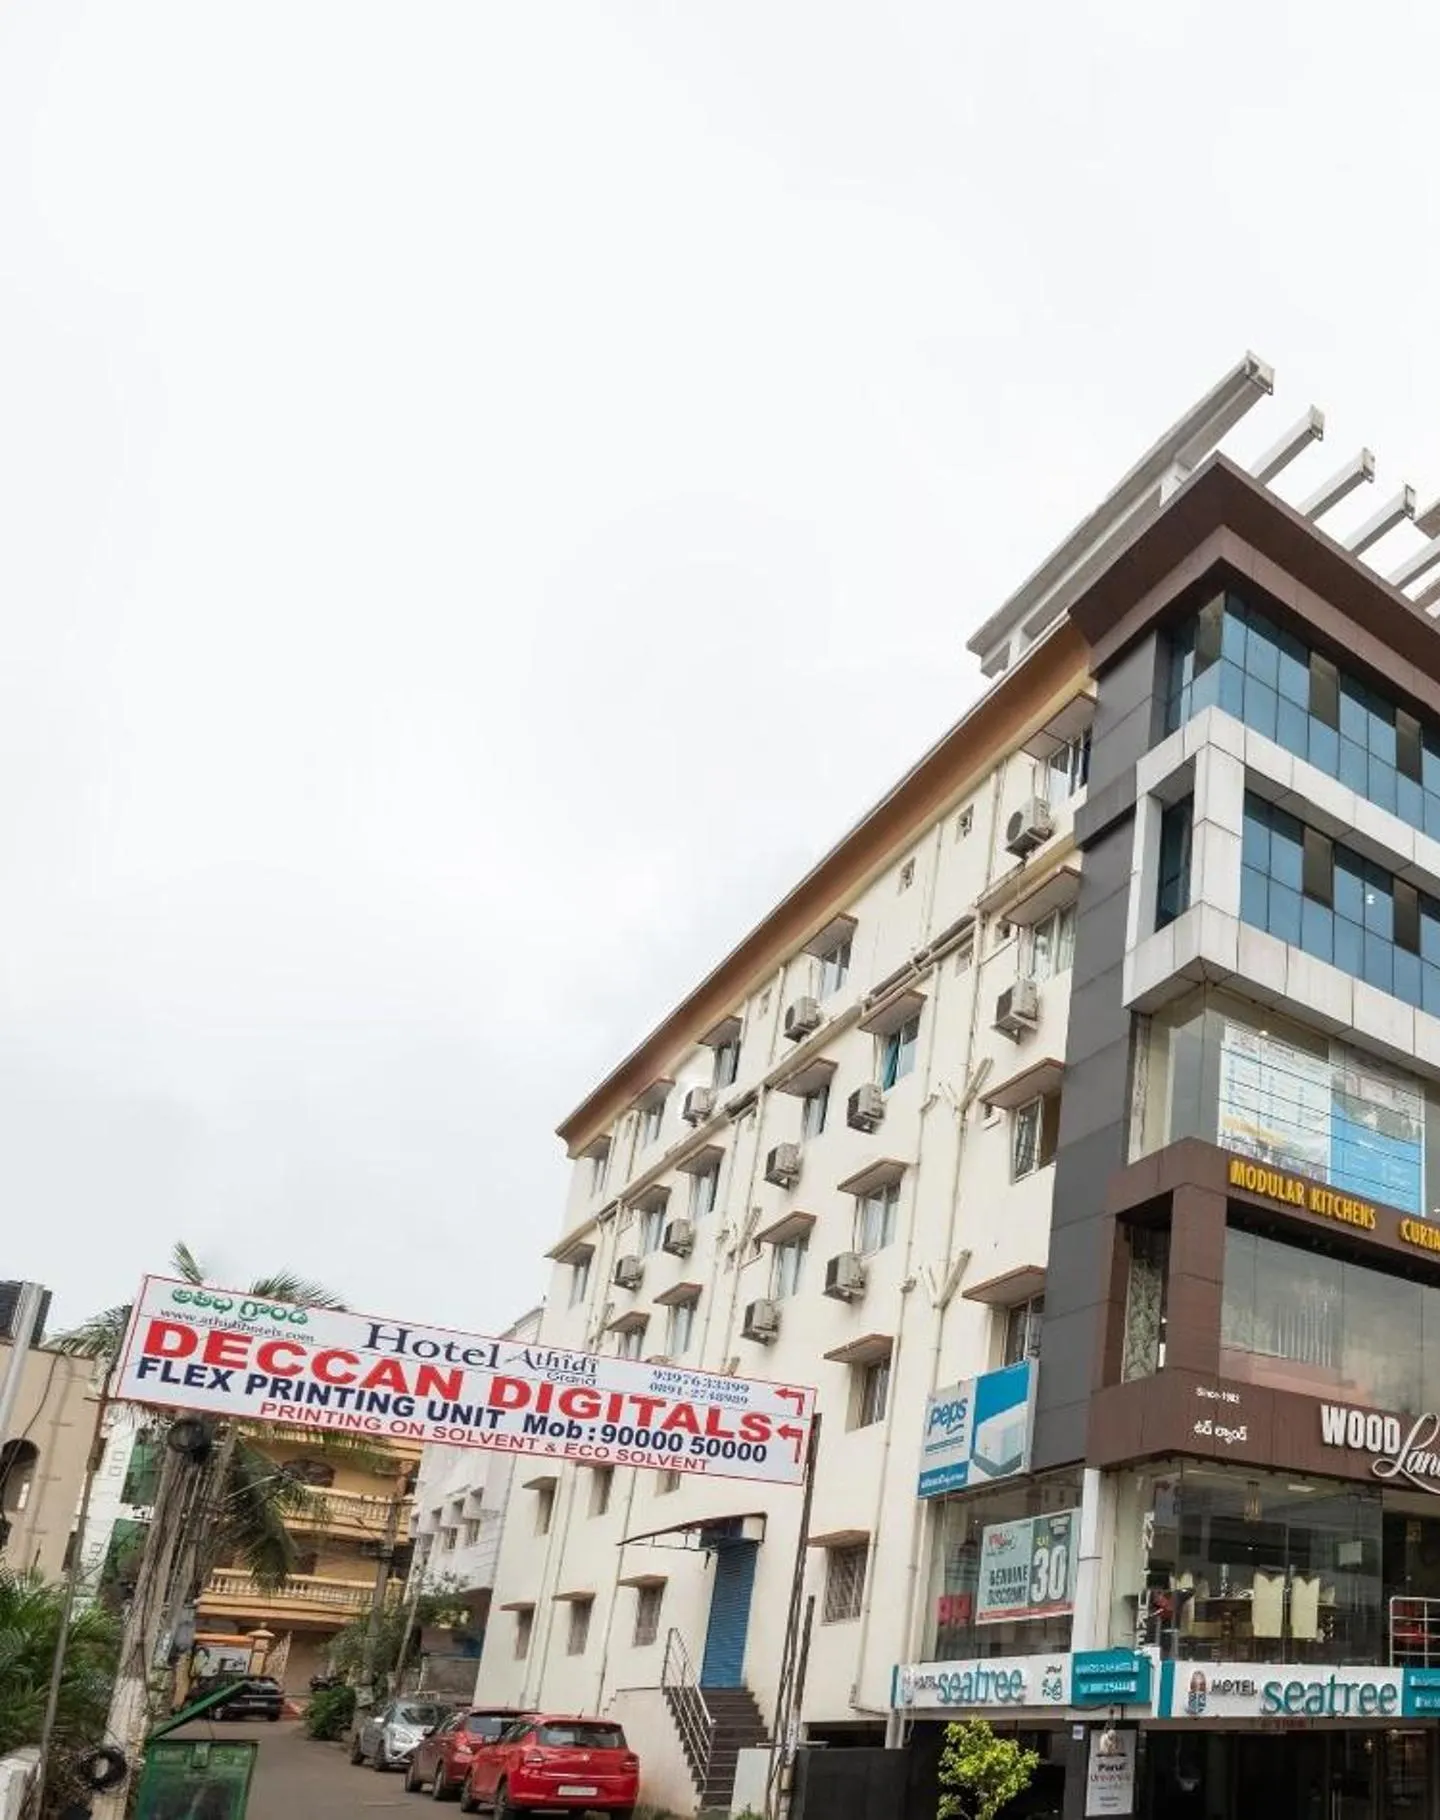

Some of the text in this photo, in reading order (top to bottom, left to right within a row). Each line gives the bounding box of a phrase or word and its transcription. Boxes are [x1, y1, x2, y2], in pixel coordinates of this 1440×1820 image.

[1229, 1158, 1305, 1207] MODULAR
[1309, 1186, 1376, 1231] KITCHENS
[363, 1322, 500, 1369] Hotel
[143, 1319, 772, 1443] DECCAN DIGITALS
[136, 1357, 236, 1393] FLEX
[245, 1373, 416, 1419] PRINTING
[427, 1400, 506, 1430] UNIT
[600, 1423, 684, 1453] 90000
[690, 1436, 768, 1463] 50000
[260, 1401, 711, 1472] PRINTING ON SOLVENT & ECO SOLVENT
[926, 1398, 969, 1437] peps
[1320, 1404, 1401, 1455] WOOD
[1030, 1545, 1067, 1602] 30
[1134, 1475, 1155, 1647] FRNITURE
[937, 1661, 1027, 1705] seatree
[1210, 1679, 1258, 1697] HOTEL
[1260, 1673, 1398, 1716] seatree
